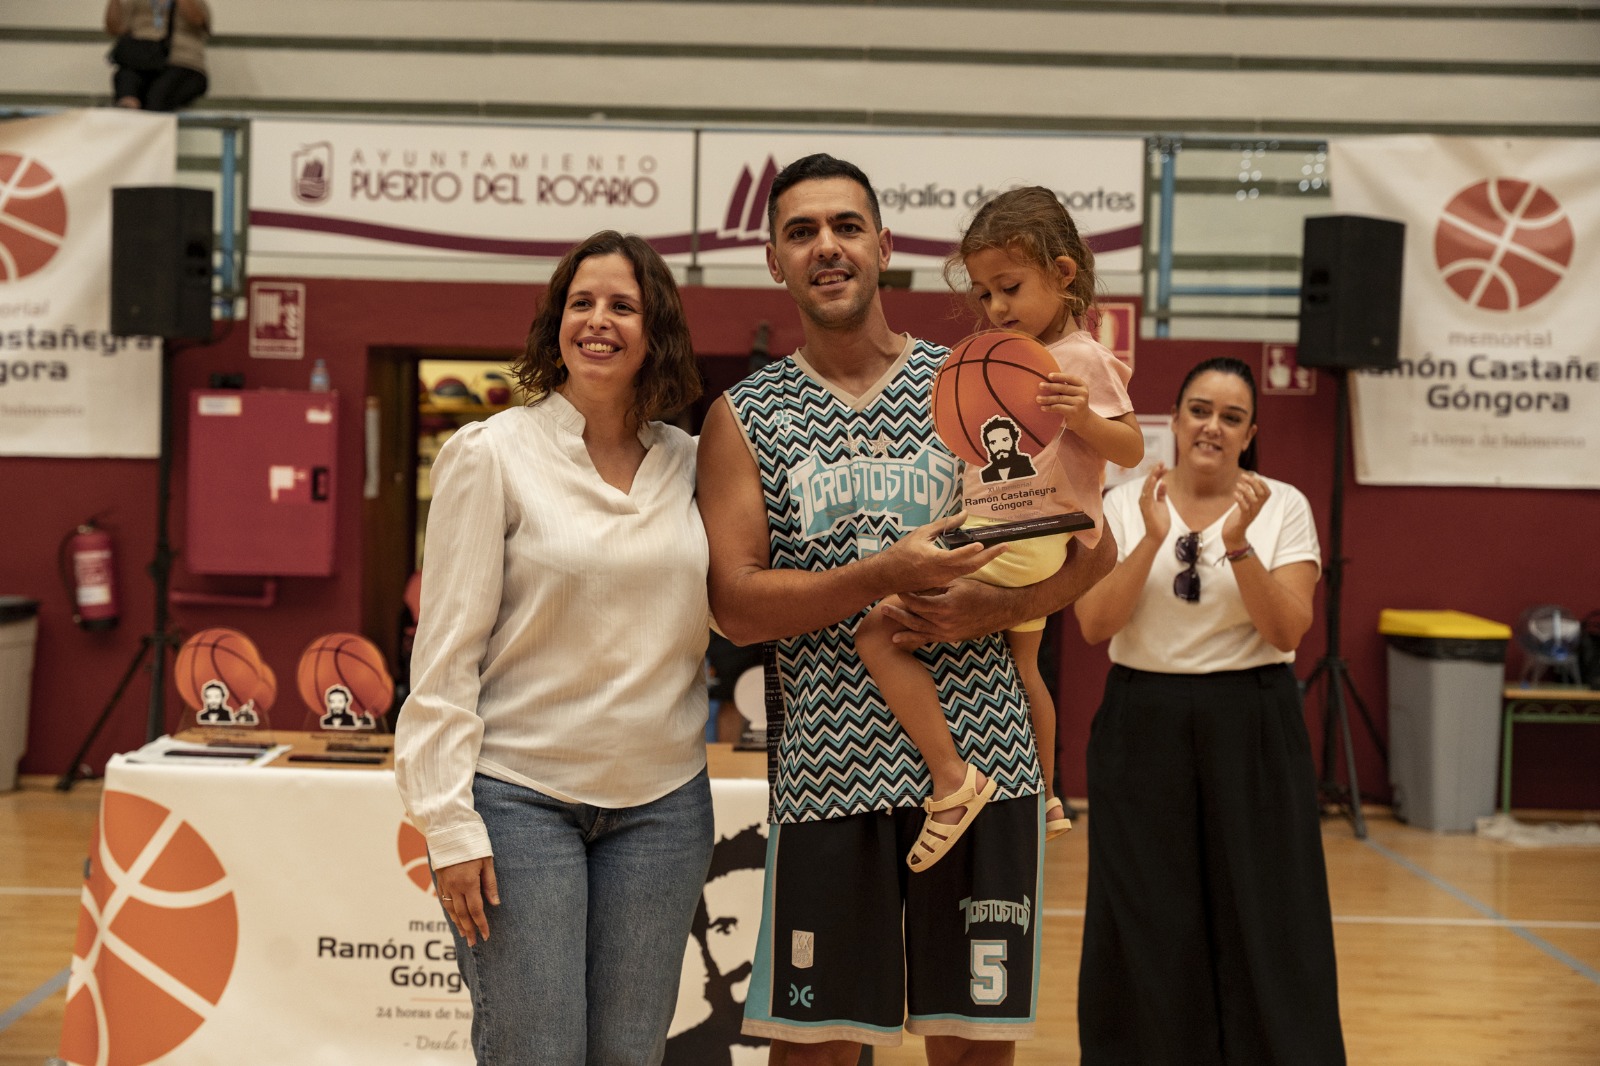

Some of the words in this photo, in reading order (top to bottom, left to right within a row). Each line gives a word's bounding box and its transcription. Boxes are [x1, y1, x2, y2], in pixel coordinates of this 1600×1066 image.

[351, 148, 657, 174] AYUNTAMIENTO
[351, 169, 462, 203] PUERTO
[472, 172, 525, 205] DEL
[537, 174, 660, 208] ROSARIO
[874, 182, 955, 214] ejalía
[1449, 329, 1552, 348] memorial
[1426, 383, 1571, 418] Góngora
[964, 494, 999, 507] Ramón
[1000, 486, 1057, 501] Castañeyra
[1001, 481, 1032, 491] memorial
[990, 499, 1033, 512] Góngora
[317, 936, 415, 961] Ramón
[390, 965, 462, 993] Góng
[970, 939, 1008, 1006] 5
[375, 1006, 393, 1019] 24
[395, 1006, 431, 1020] horas
[434, 1006, 452, 1020] de
